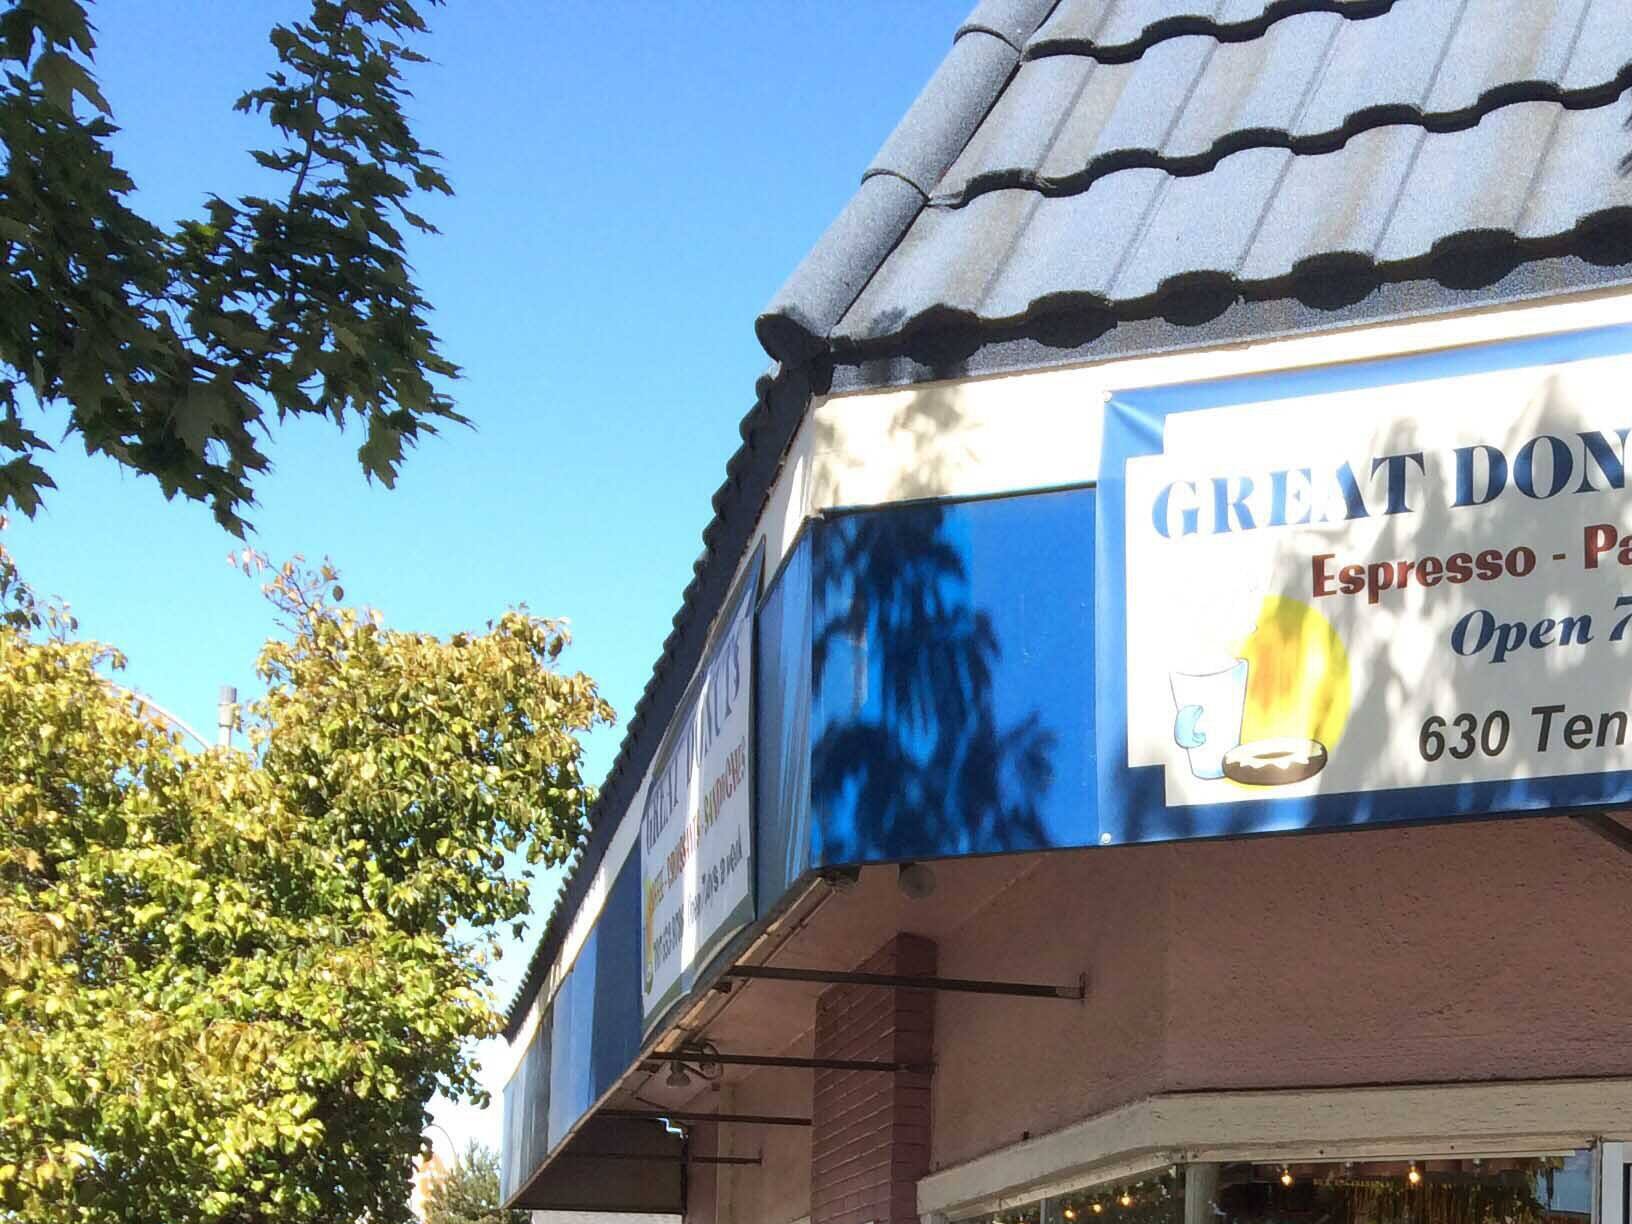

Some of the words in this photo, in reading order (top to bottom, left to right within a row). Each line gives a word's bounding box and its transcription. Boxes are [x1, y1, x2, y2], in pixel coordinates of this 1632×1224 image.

[1152, 451, 1425, 538] GREAT
[1312, 546, 1536, 604] Espresso
[1450, 608, 1594, 664] Open
[1419, 709, 1511, 762] 630
